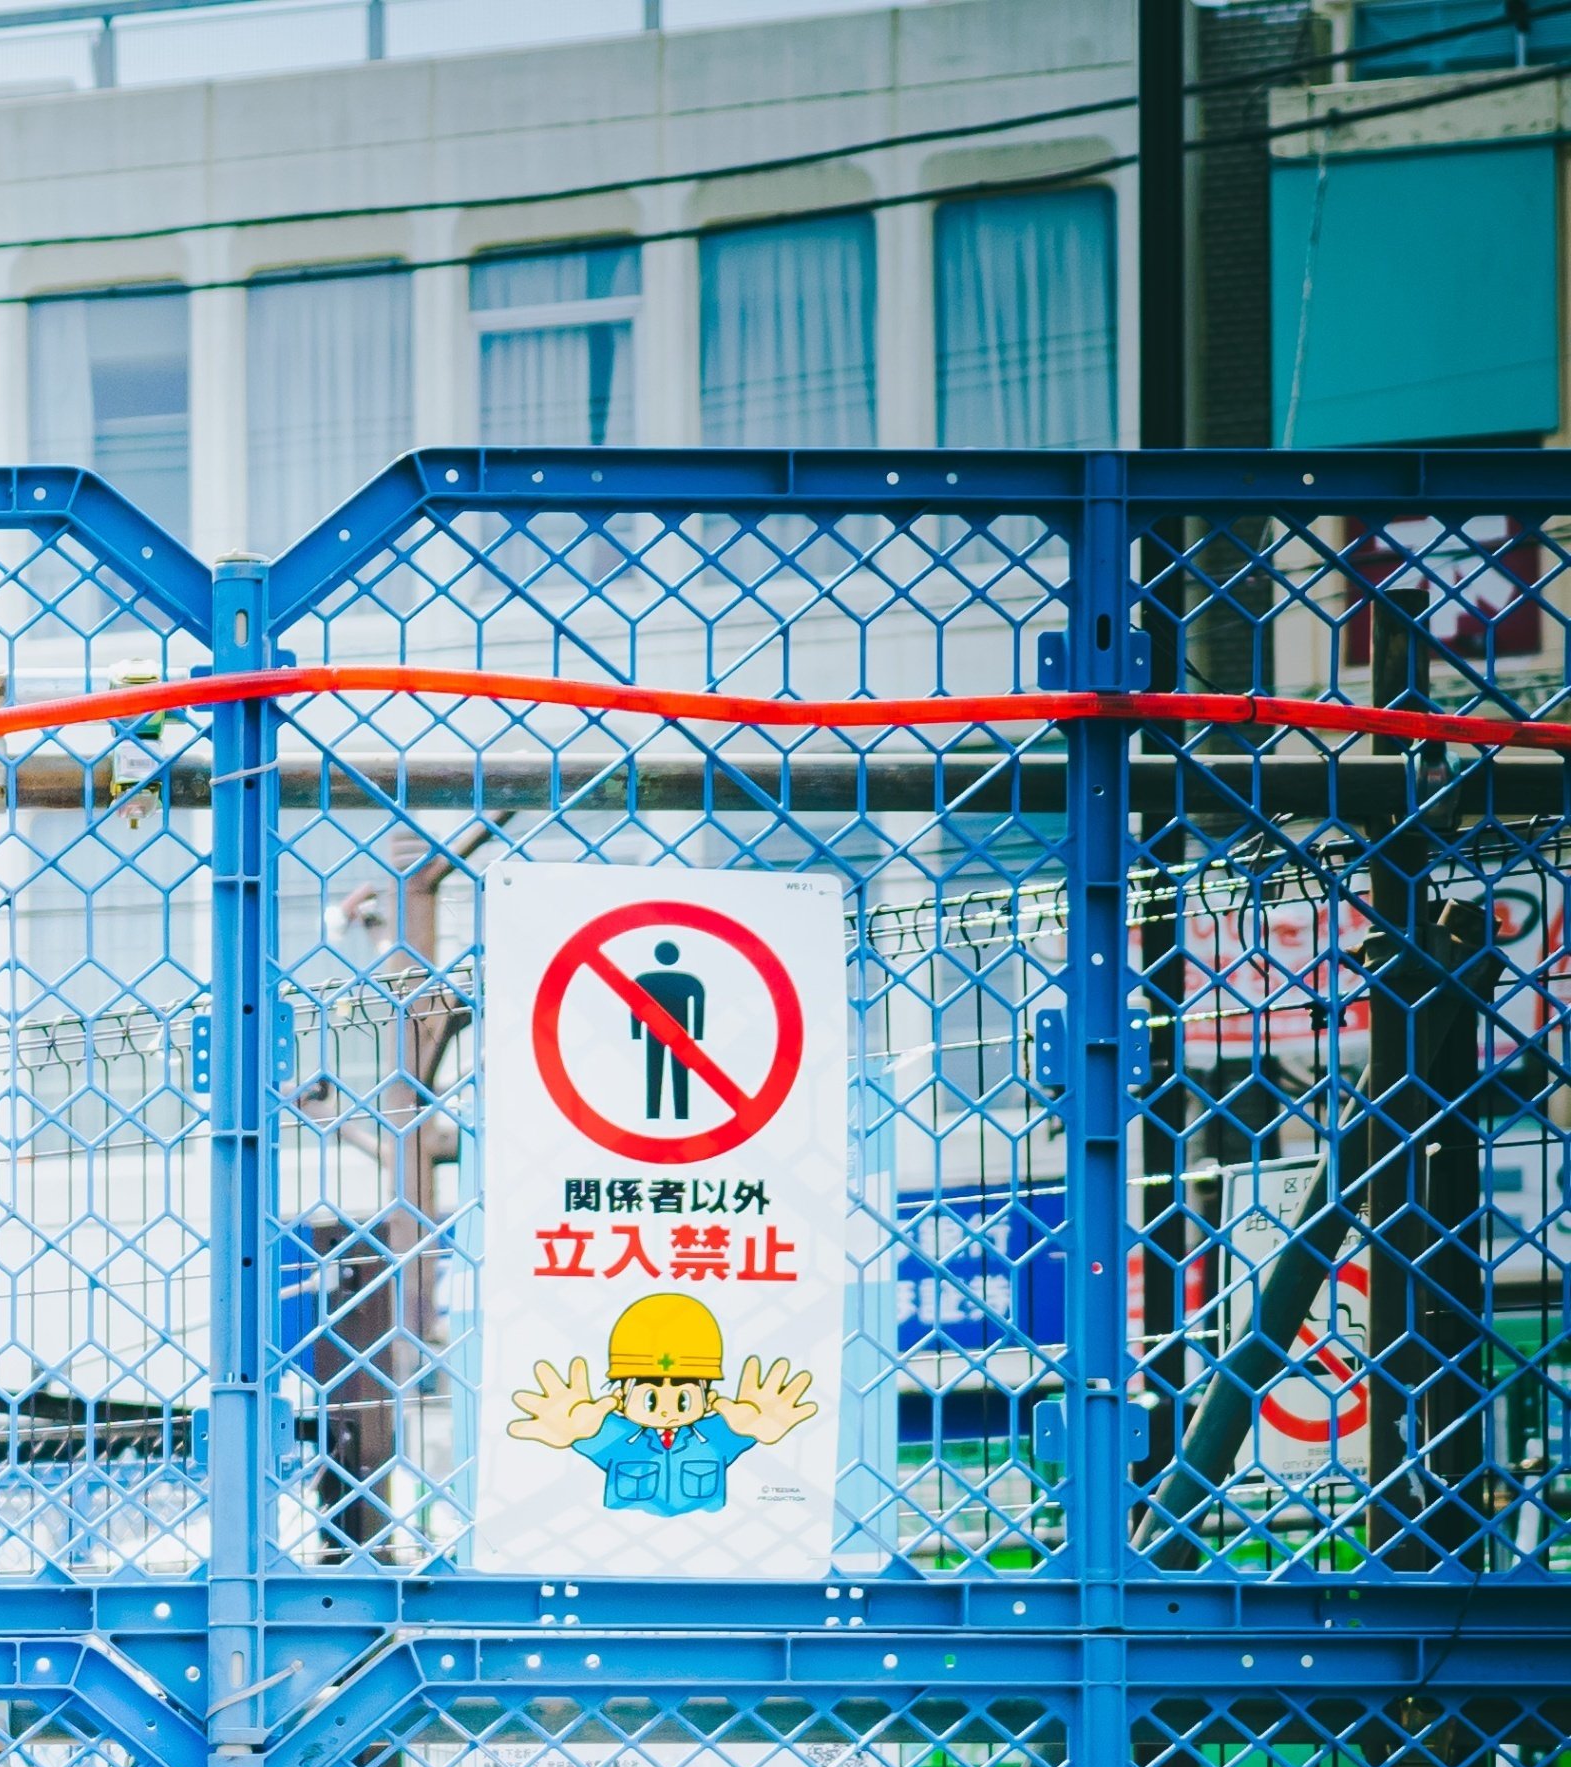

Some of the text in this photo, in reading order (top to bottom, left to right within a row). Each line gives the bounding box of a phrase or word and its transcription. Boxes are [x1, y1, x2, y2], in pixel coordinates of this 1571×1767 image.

[563, 1177, 771, 1216] 関係者以外
[533, 1222, 798, 1283] 立入禁止
